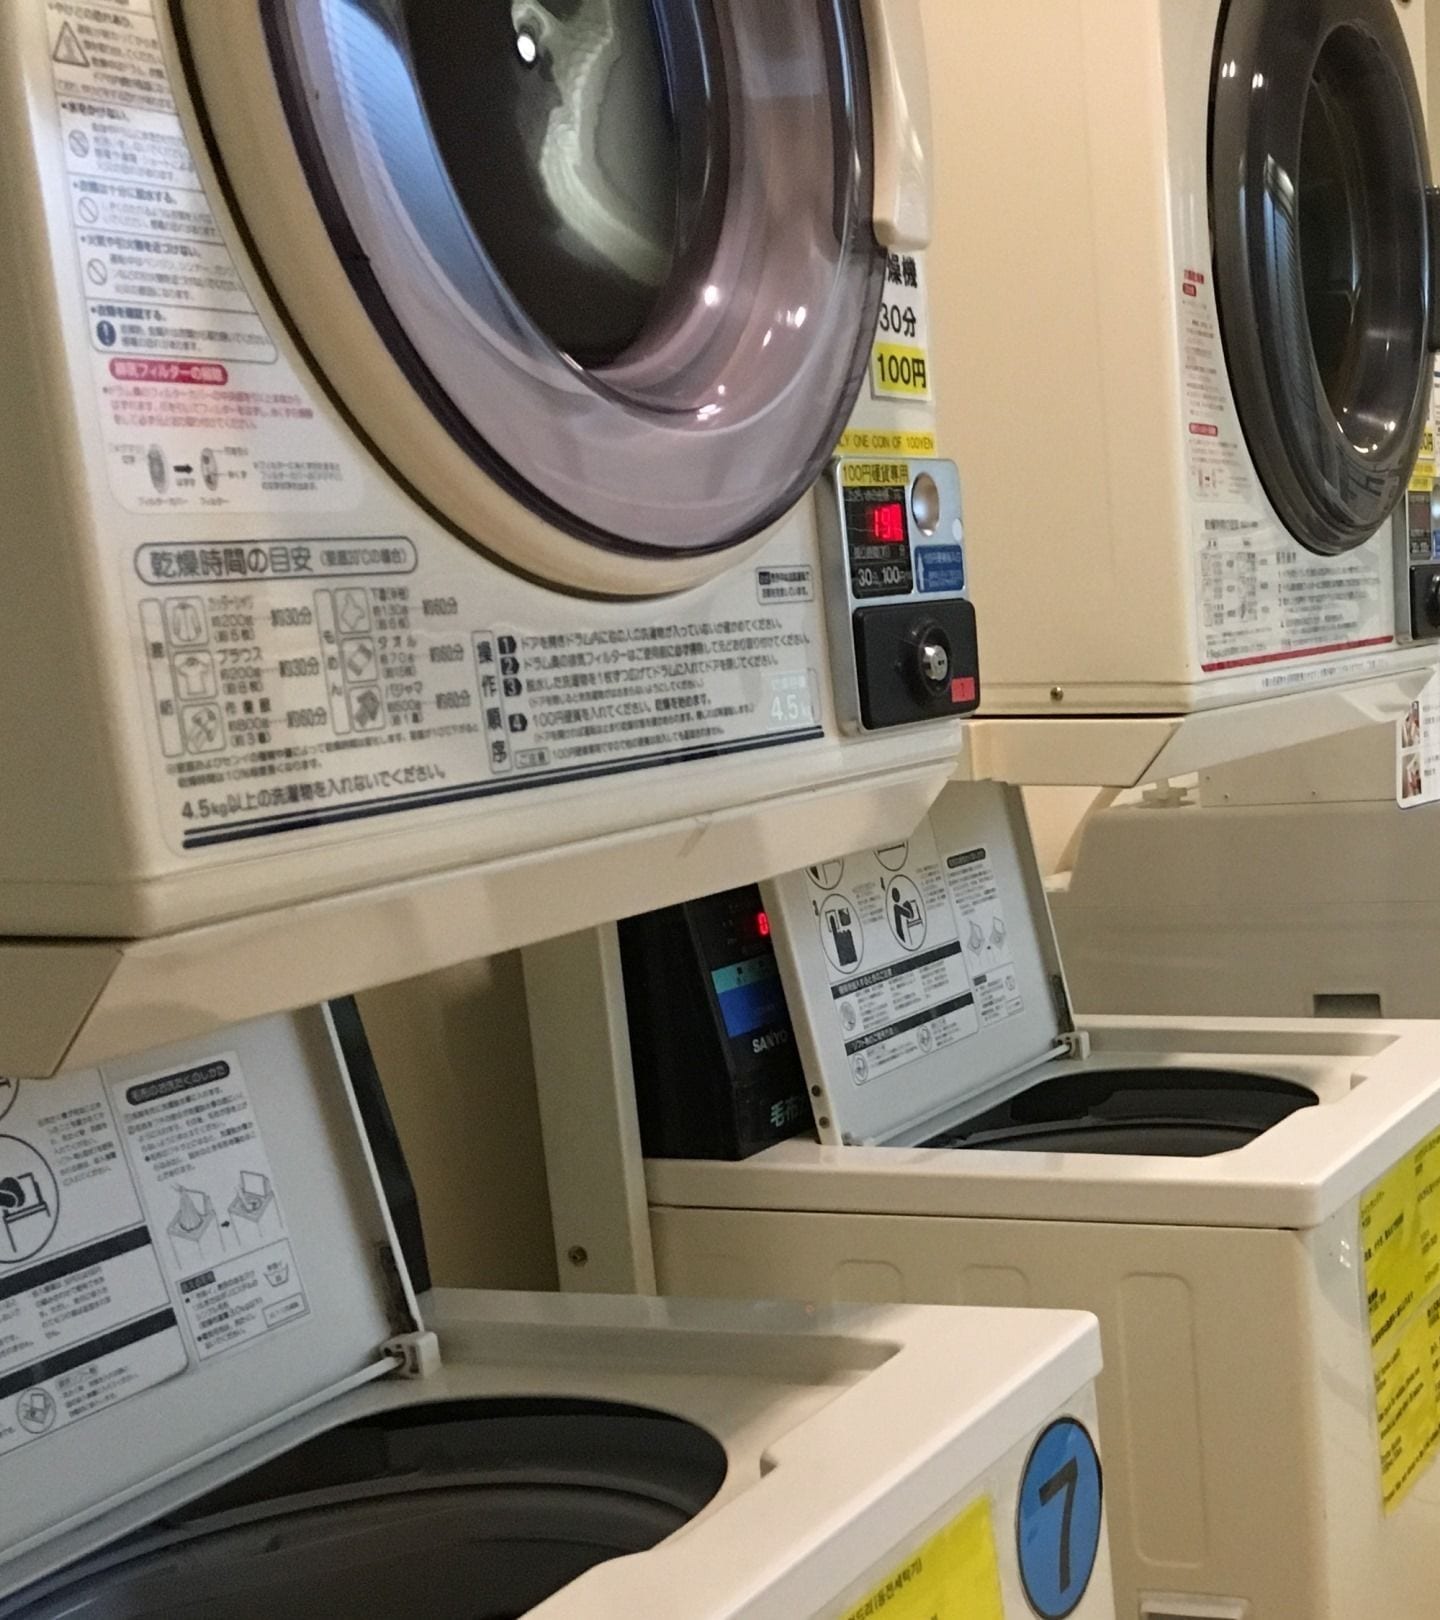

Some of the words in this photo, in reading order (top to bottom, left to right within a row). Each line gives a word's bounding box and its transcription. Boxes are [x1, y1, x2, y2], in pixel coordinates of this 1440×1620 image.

[880, 303, 917, 338] 30分
[877, 353, 927, 388] 100円
[150, 547, 314, 579] 乾燥時間の目安
[752, 1030, 788, 1053] SANYO
[1038, 1456, 1079, 1594] 7
